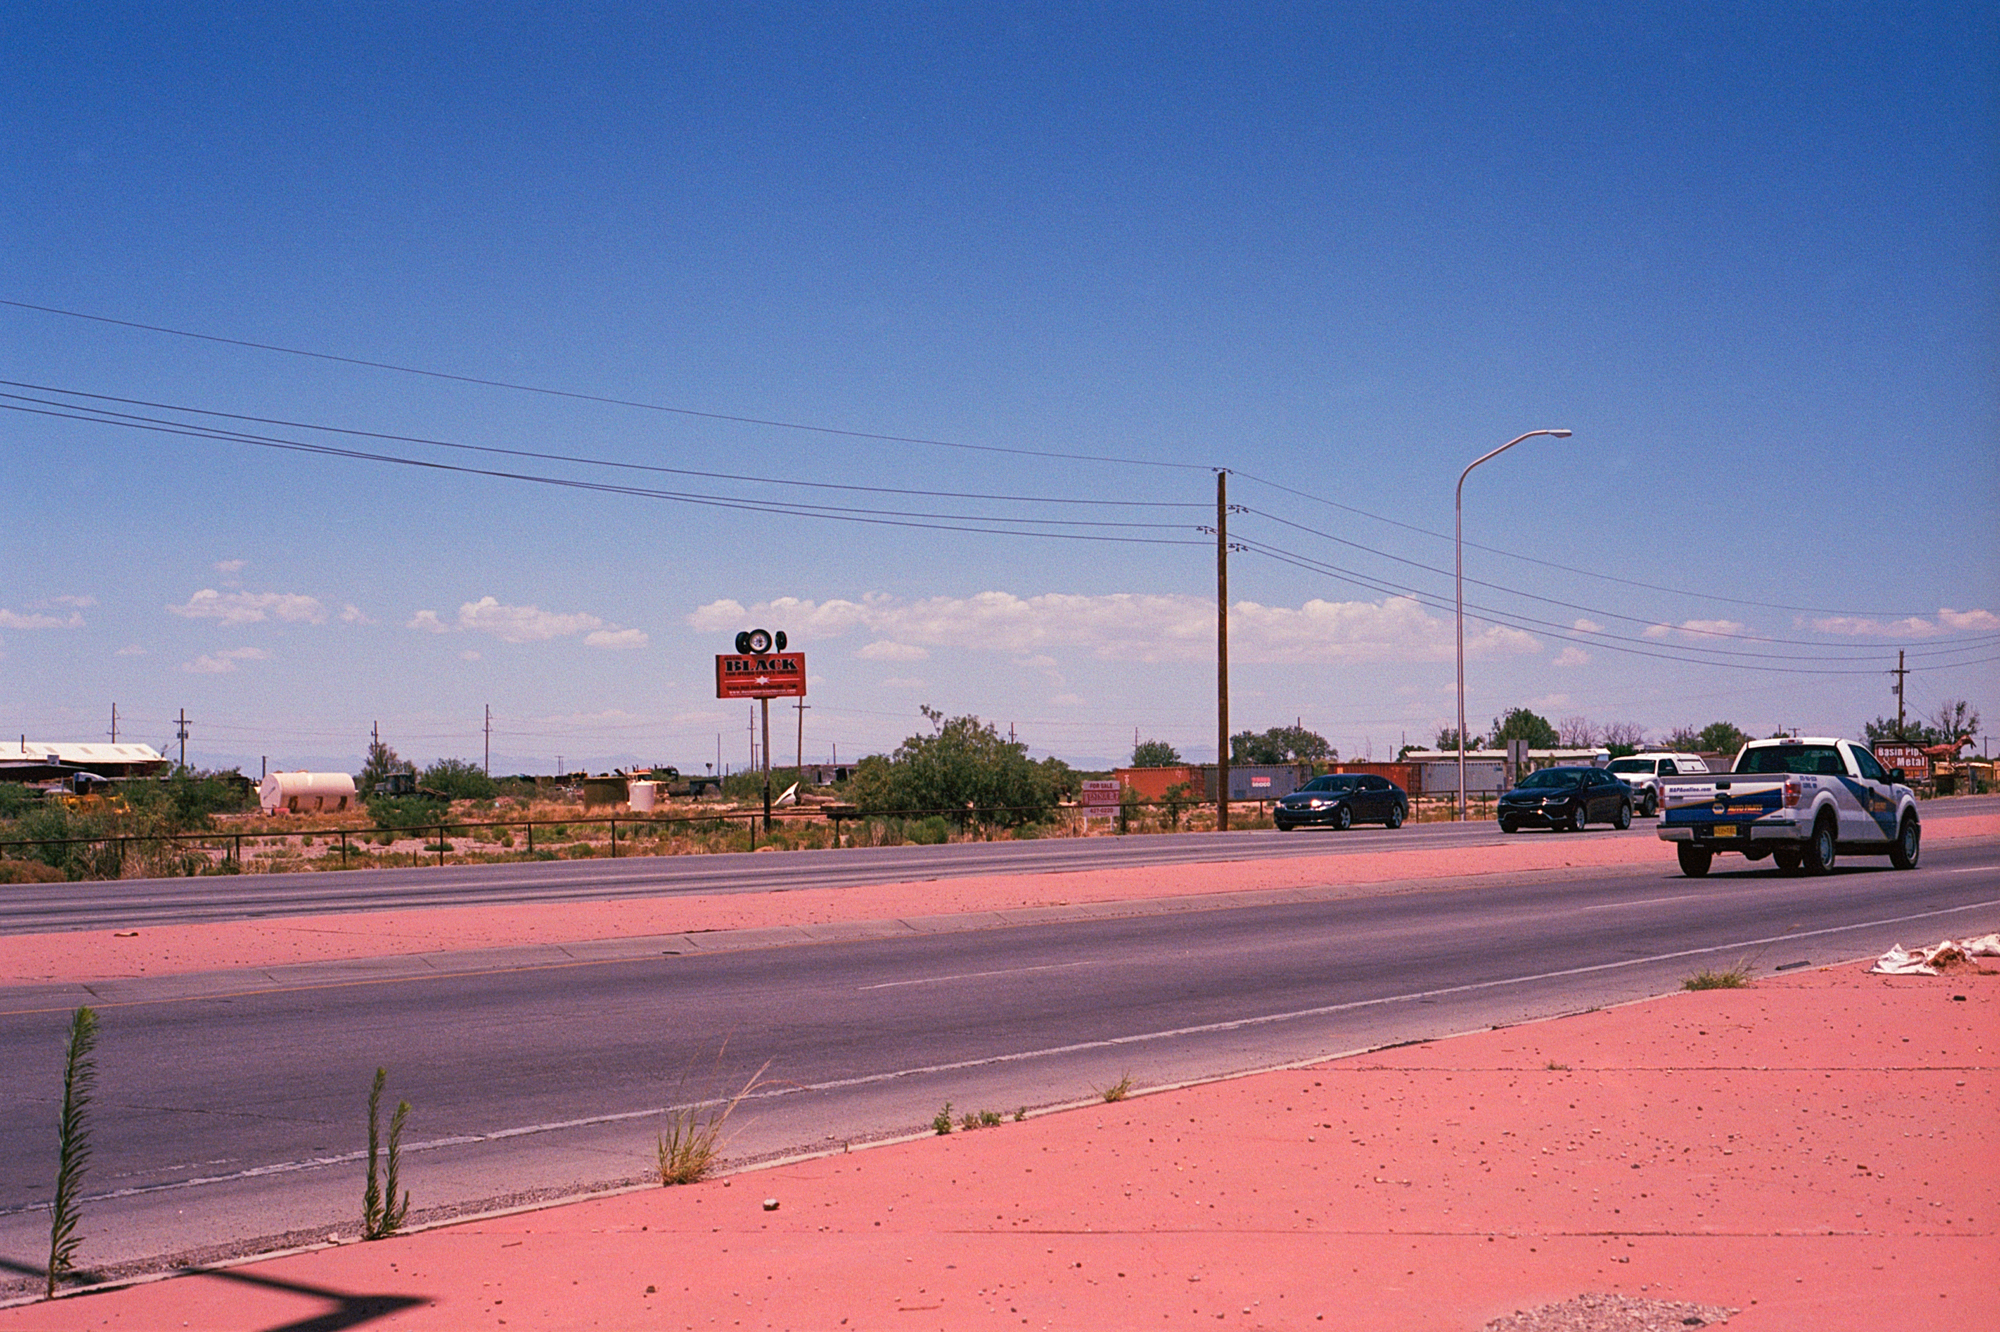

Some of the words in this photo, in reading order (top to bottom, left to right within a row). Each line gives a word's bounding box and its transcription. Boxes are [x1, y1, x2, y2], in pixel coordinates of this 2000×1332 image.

[725, 659, 798, 672] BLACK
[1878, 747, 1903, 756] Basin
[1897, 757, 1925, 767] Metal
